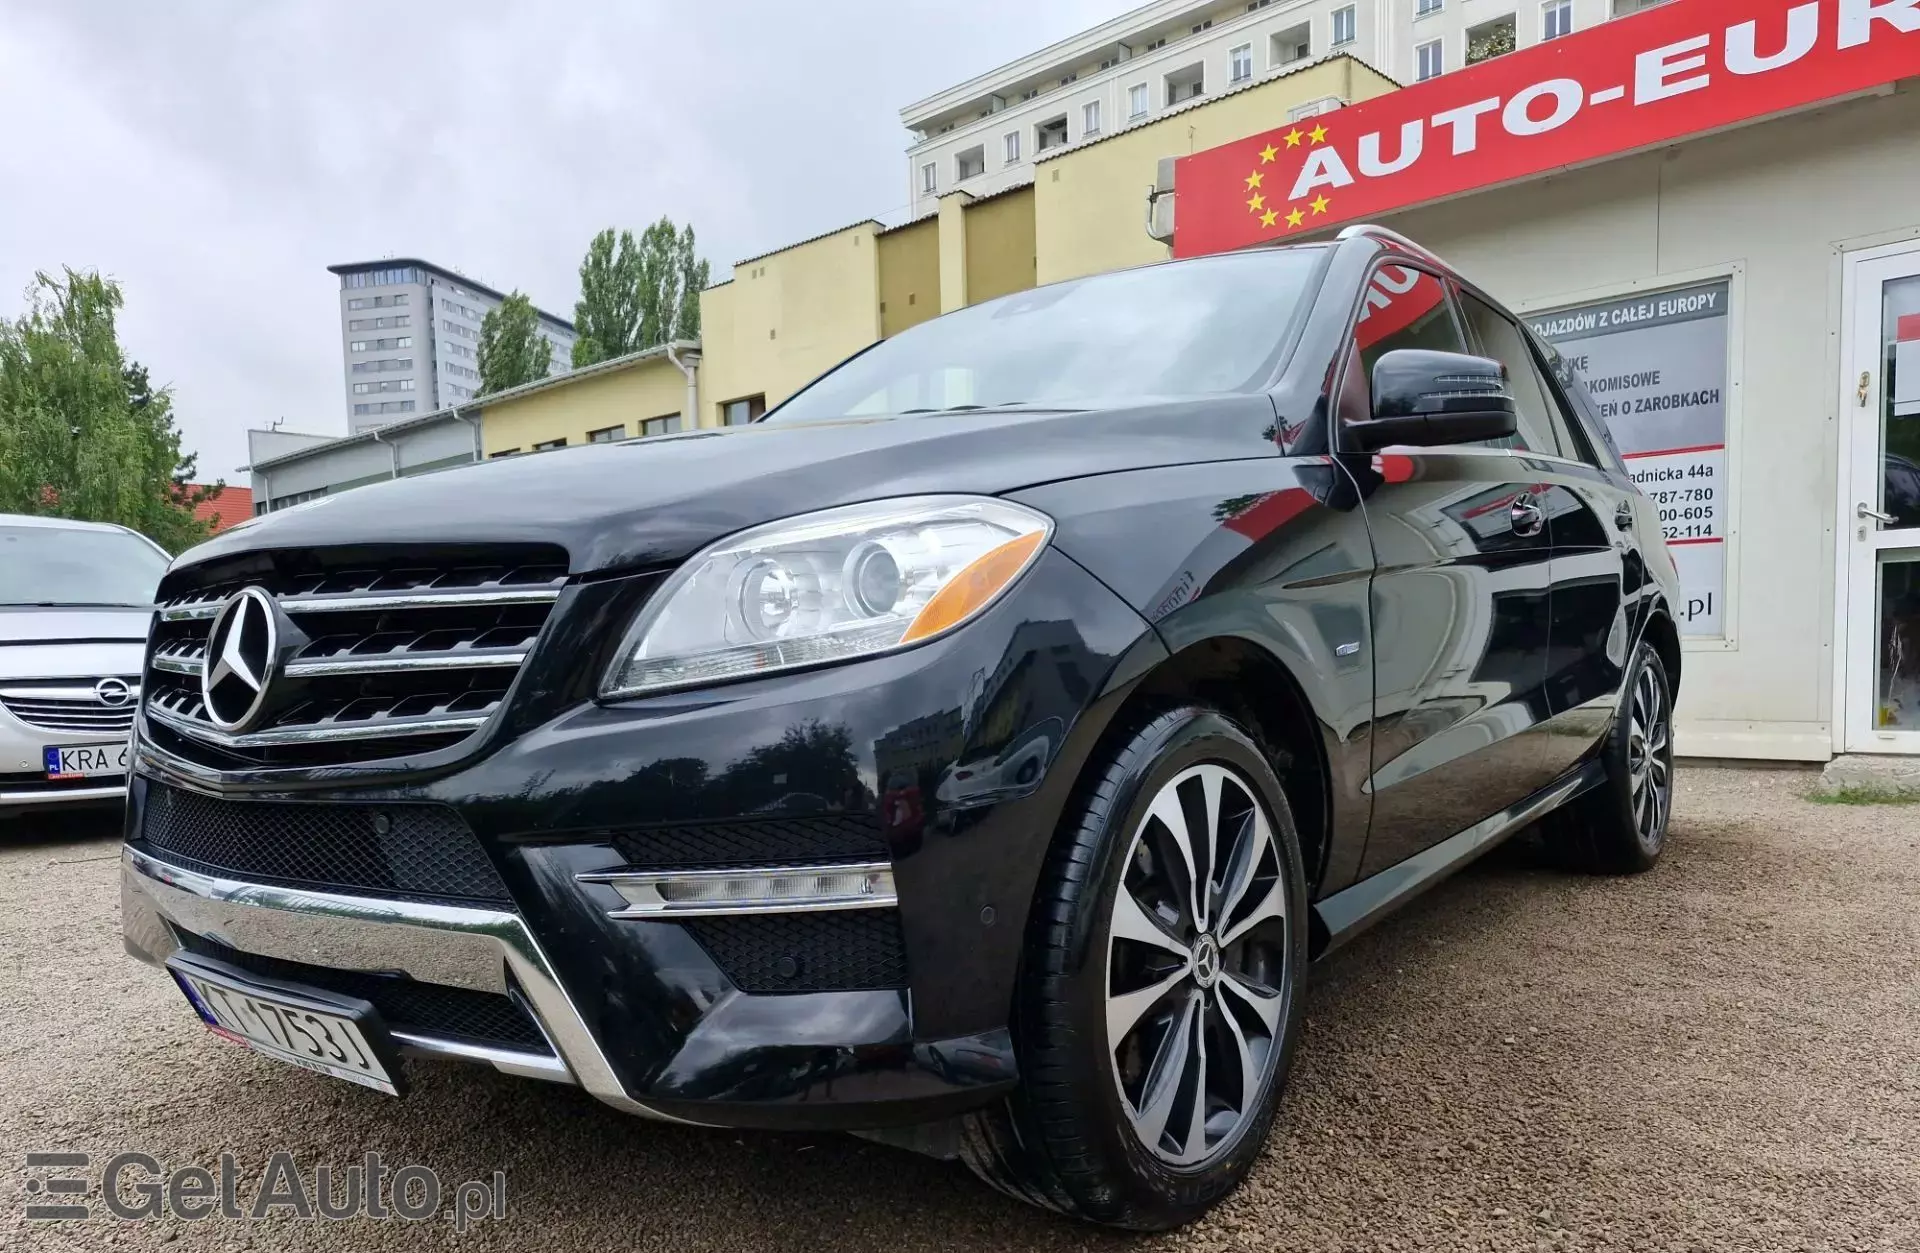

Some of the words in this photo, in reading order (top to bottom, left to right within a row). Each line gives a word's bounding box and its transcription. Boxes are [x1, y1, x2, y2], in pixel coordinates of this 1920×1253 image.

[1288, 0, 1920, 201] AUTO-EUR
[1599, 312, 1608, 327] Z
[1611, 303, 1654, 324] CAŁEJ
[1658, 292, 1717, 317] EUROPY
[1596, 399, 1618, 417] EŃ
[1622, 400, 1631, 415] O
[1634, 389, 1720, 413] ZAROBKACH
[1688, 464, 1713, 478] 44a
[61, 748, 109, 771] KRA
